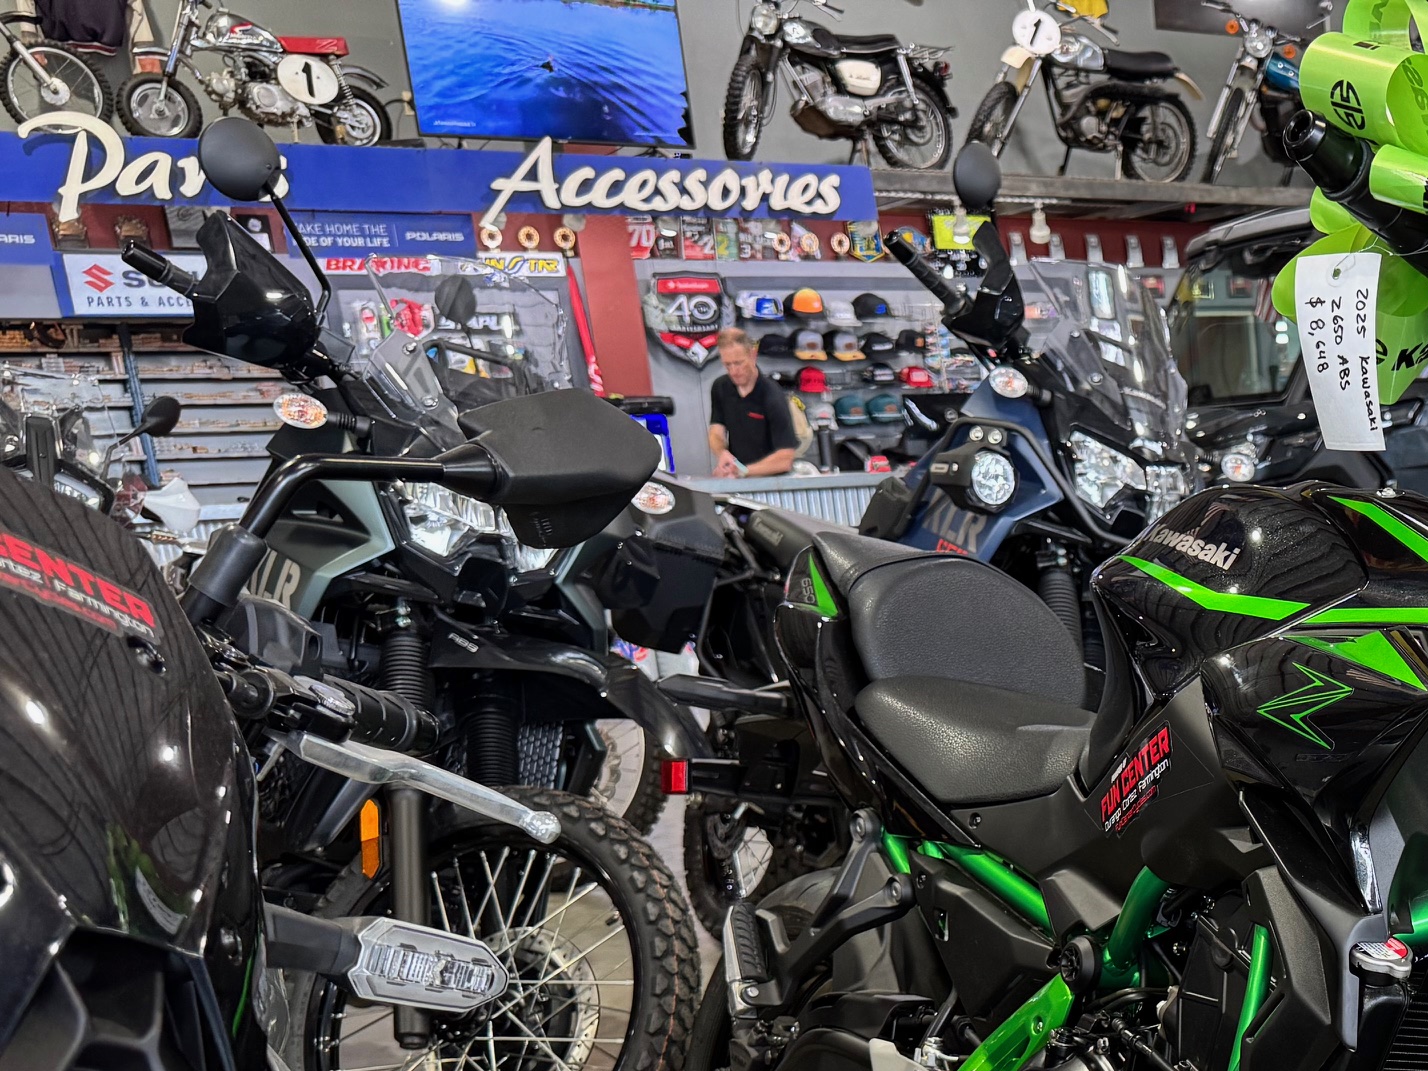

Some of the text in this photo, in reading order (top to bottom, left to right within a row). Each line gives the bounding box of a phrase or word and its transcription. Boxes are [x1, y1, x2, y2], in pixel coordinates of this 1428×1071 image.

[302, 61, 316, 98] 1
[18, 111, 289, 222] Par
[479, 136, 841, 226] Accessories
[320, 237, 332, 247] OF
[334, 237, 365, 247] YOUR
[367, 237, 390, 248] LIFE
[324, 224, 354, 235] HOME
[361, 224, 388, 236] THE
[405, 231, 464, 242] POLARIS
[87, 295, 133, 308] PARTS
[141, 296, 150, 307] &
[1337, 354, 1351, 391] ABS
[1356, 288, 1378, 431] 2025 Kawasaki
[1144, 523, 1241, 571] Kawasaki
[250, 548, 301, 617] LR
[53, 578, 155, 639] Farmington
[448, 633, 480, 654] ABS
[1101, 781, 1121, 823] FUN
[1120, 726, 1171, 798] CENTER
